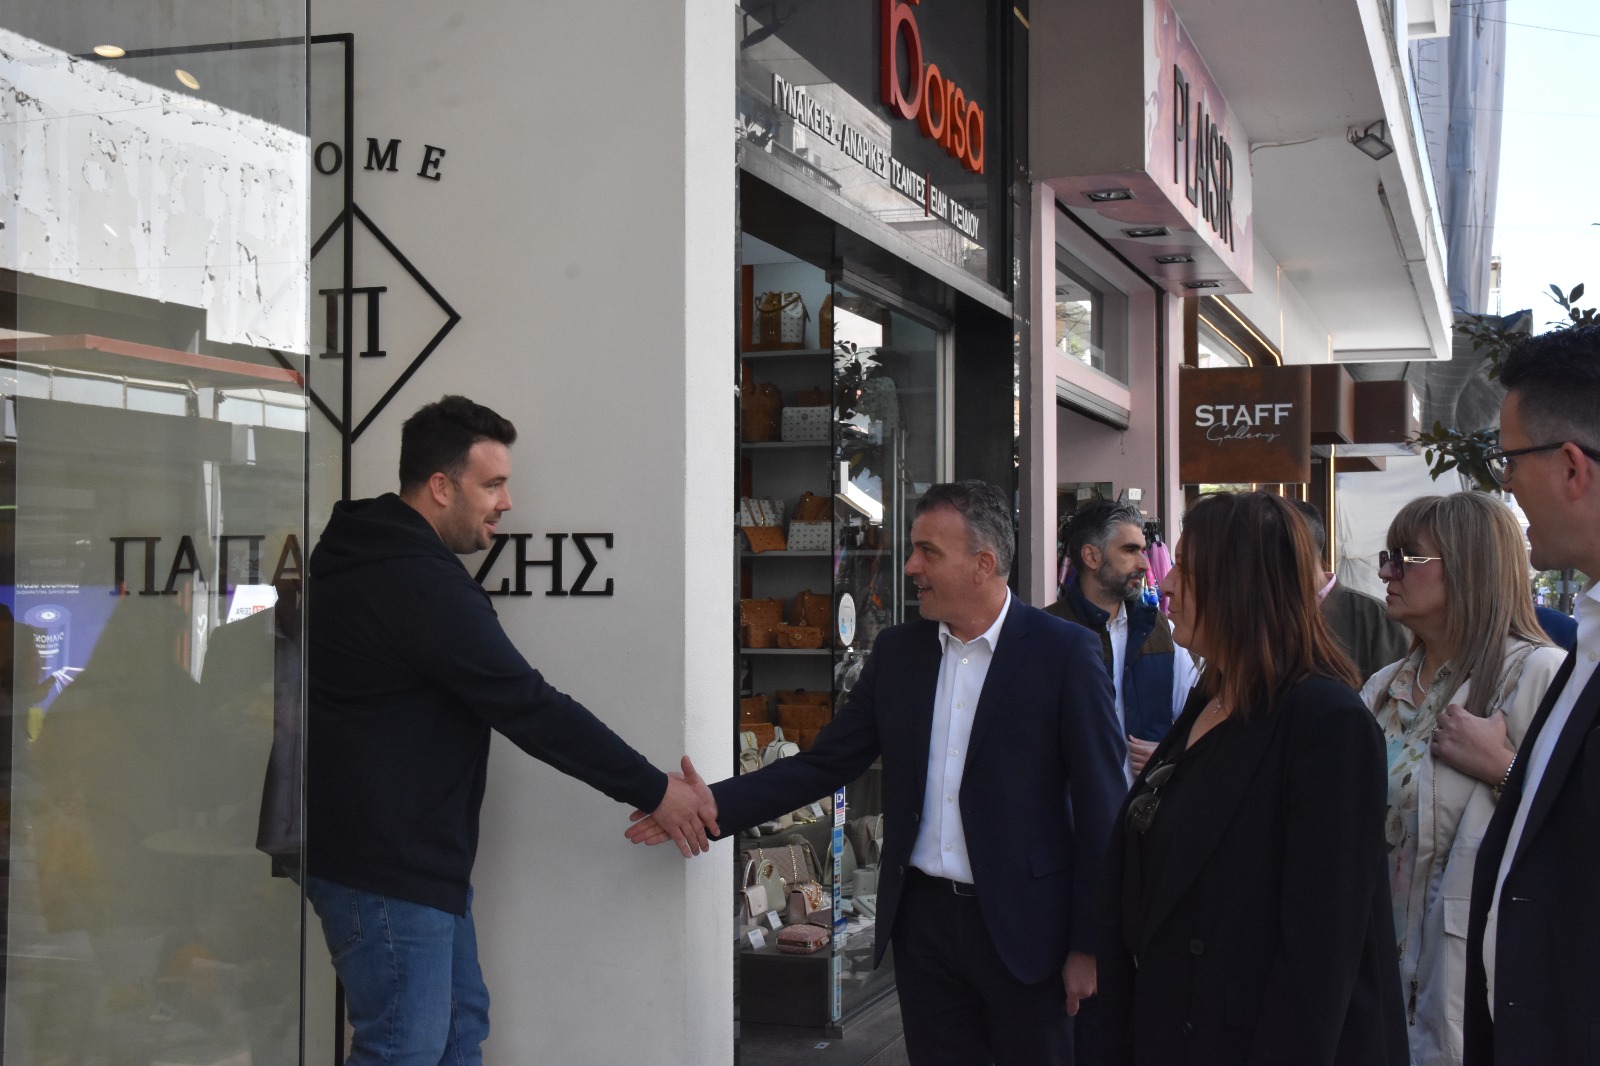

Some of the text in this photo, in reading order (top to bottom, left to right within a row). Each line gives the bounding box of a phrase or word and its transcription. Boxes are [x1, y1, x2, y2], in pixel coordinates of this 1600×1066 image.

[882, 0, 984, 174] borsa
[314, 137, 446, 181] OME
[1173, 64, 1234, 252] PLAISIR
[889, 156, 926, 206] ΤΣΑΝΤΕΣ
[931, 184, 949, 219] ΕΙΔΗ
[1195, 403, 1293, 427] STAFF
[1206, 422, 1280, 446] Gallery
